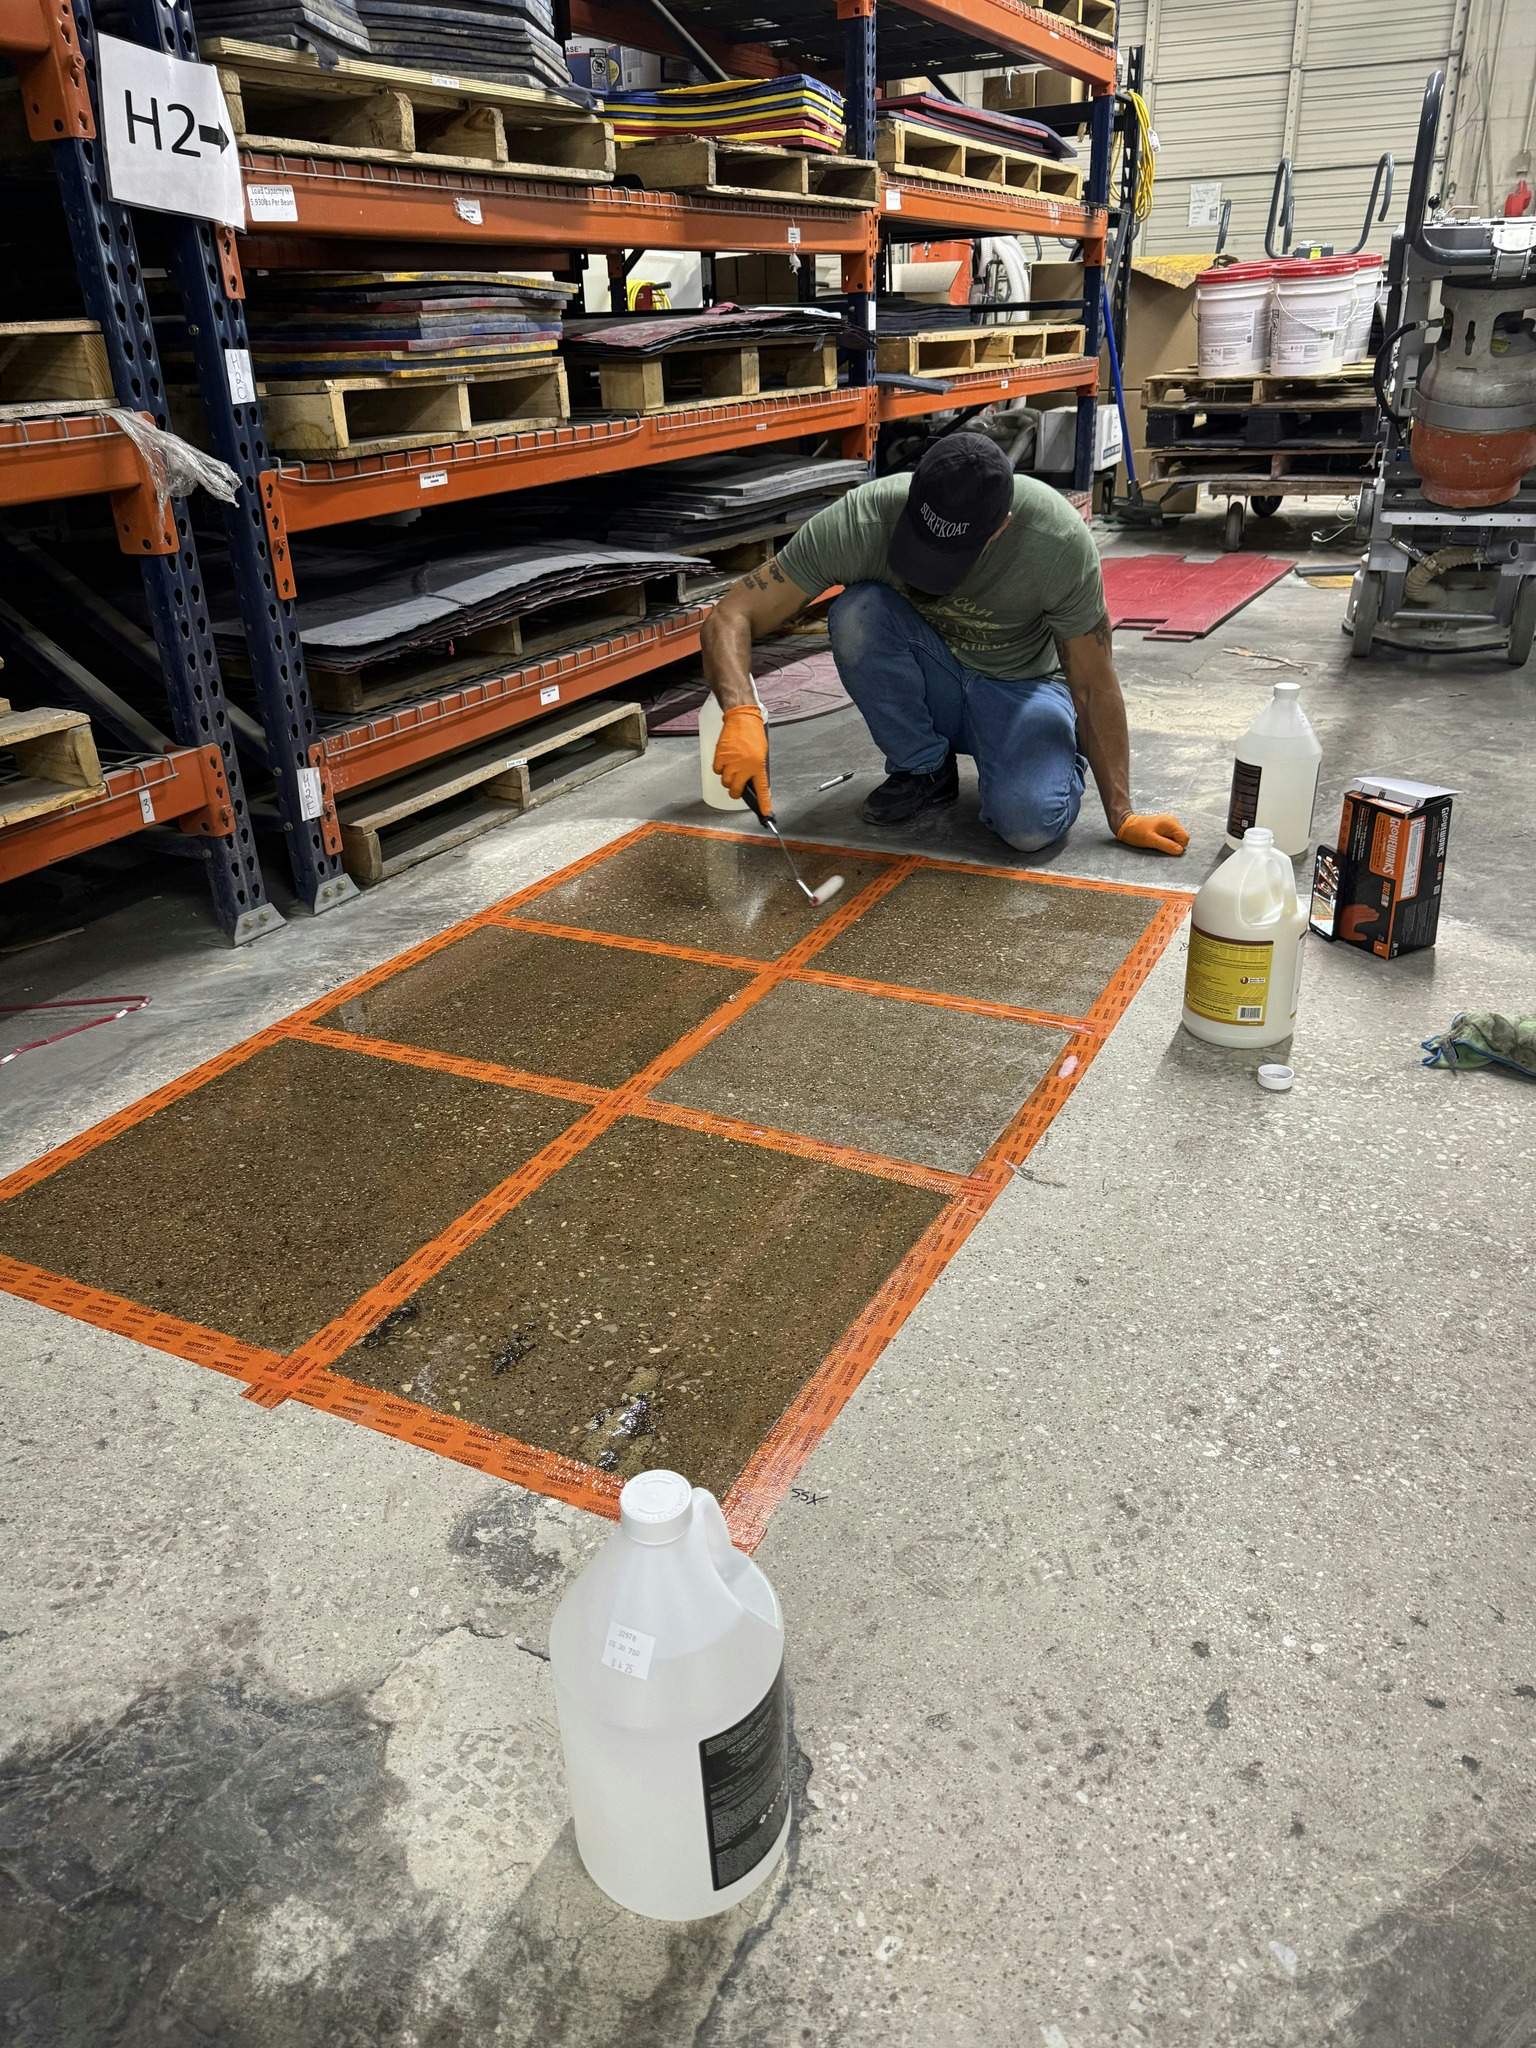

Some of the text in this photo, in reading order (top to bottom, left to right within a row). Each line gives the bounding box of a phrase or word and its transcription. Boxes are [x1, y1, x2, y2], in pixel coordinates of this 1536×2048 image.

[125, 89, 201, 158] H2
[251, 187, 264, 195] Load
[264, 187, 284, 197] Capacity
[271, 198, 280, 206] Per
[280, 198, 295, 206] Beam
[920, 502, 970, 538] SURFKOAT
[1383, 817, 1401, 876] GLOVEWORKS
[1437, 806, 1450, 858] GLOVEWORKS
